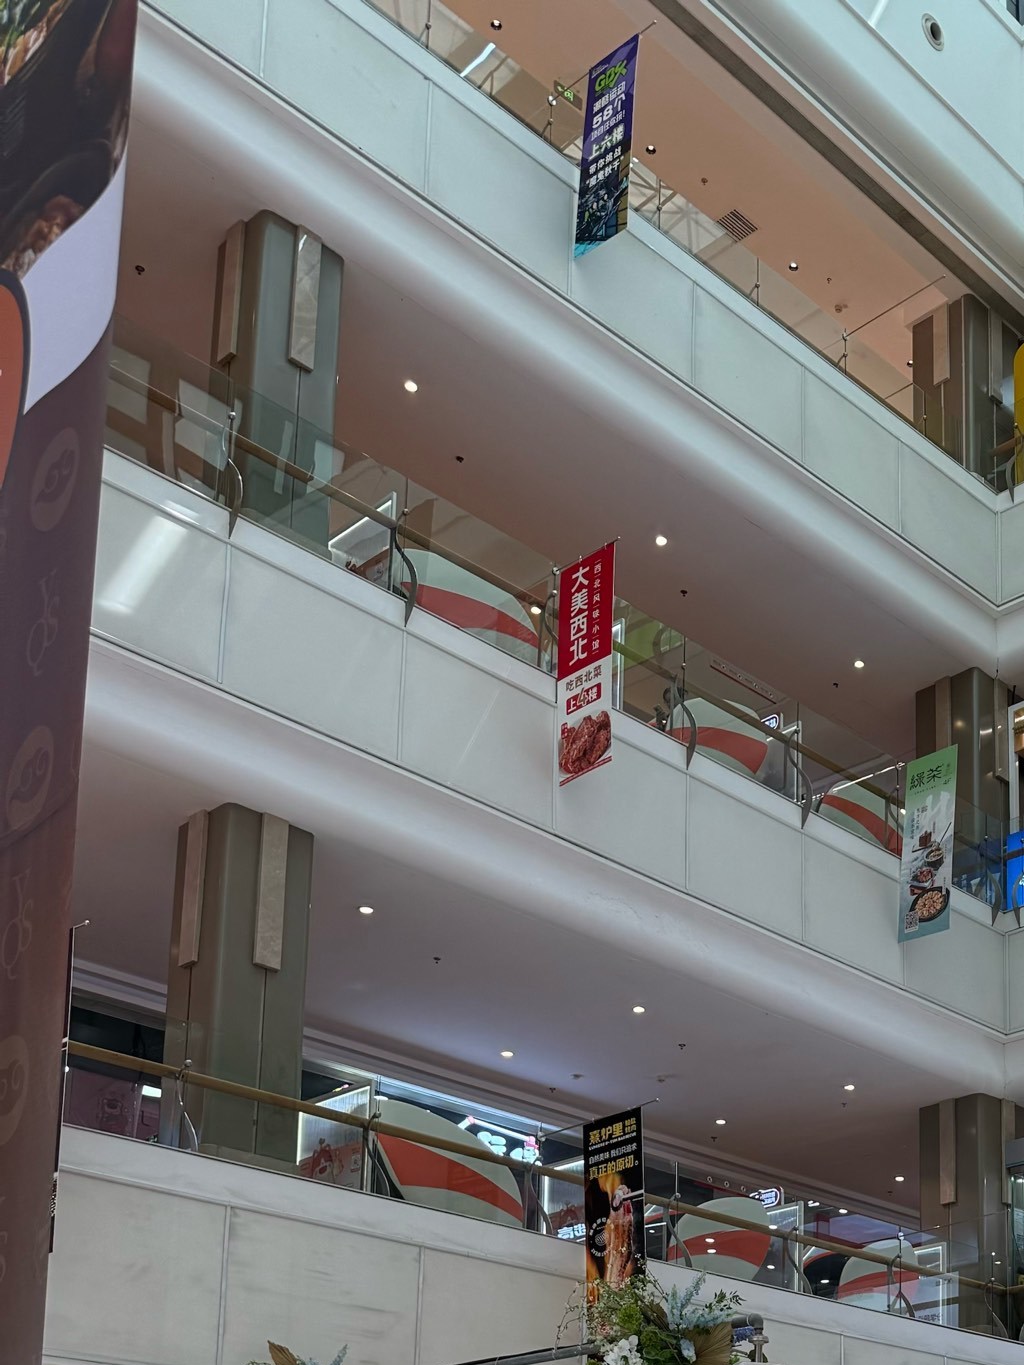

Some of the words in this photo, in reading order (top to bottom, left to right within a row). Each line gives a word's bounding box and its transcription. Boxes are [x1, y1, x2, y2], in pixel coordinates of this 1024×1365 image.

[592, 93, 625, 128] 58个
[588, 123, 624, 162] 上六楼
[569, 566, 589, 667] 大美西北
[565, 664, 602, 692] 吃西北菜
